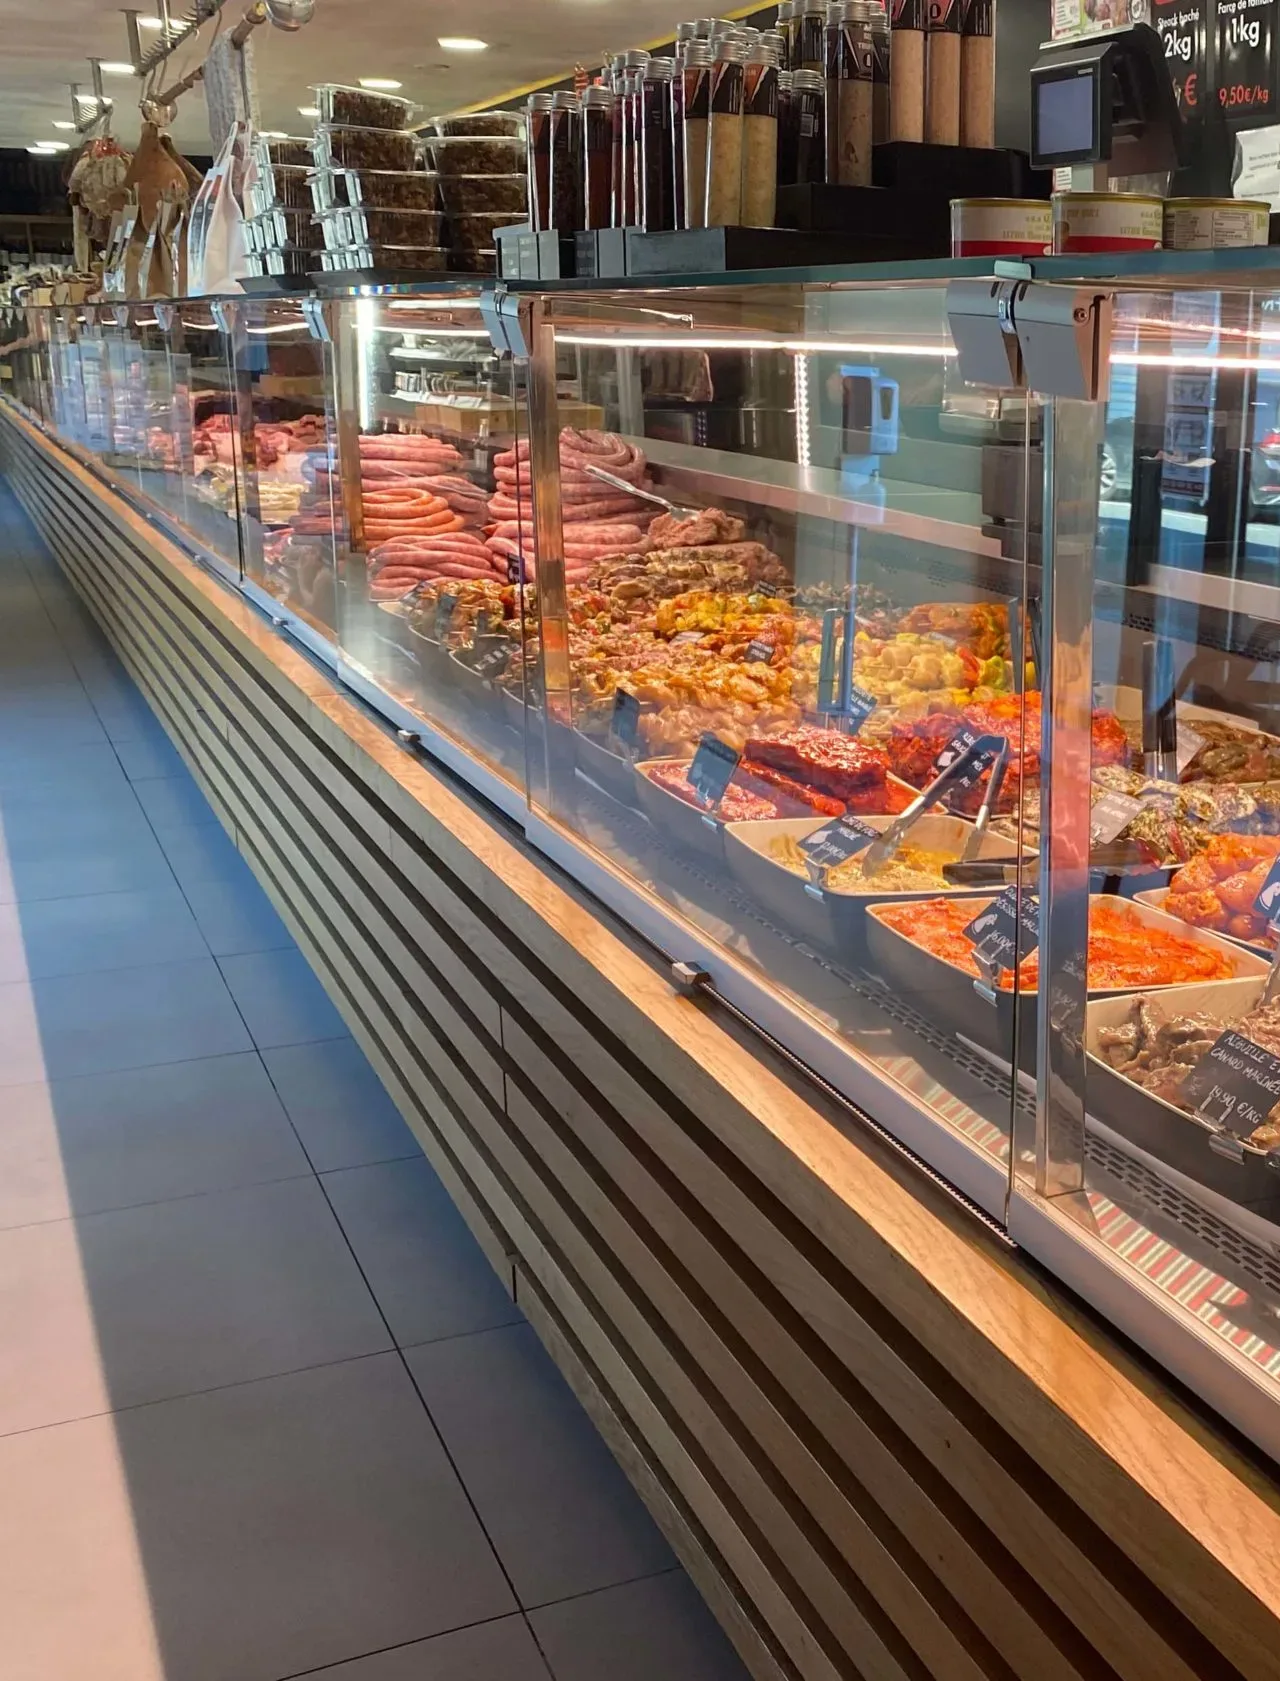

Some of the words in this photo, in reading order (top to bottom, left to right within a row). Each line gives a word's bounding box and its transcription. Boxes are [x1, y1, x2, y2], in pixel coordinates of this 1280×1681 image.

[1164, 29, 1191, 61] 2kg
[1231, 14, 1260, 48] 1kg
[1210, 1047, 1244, 1071] CANARD
